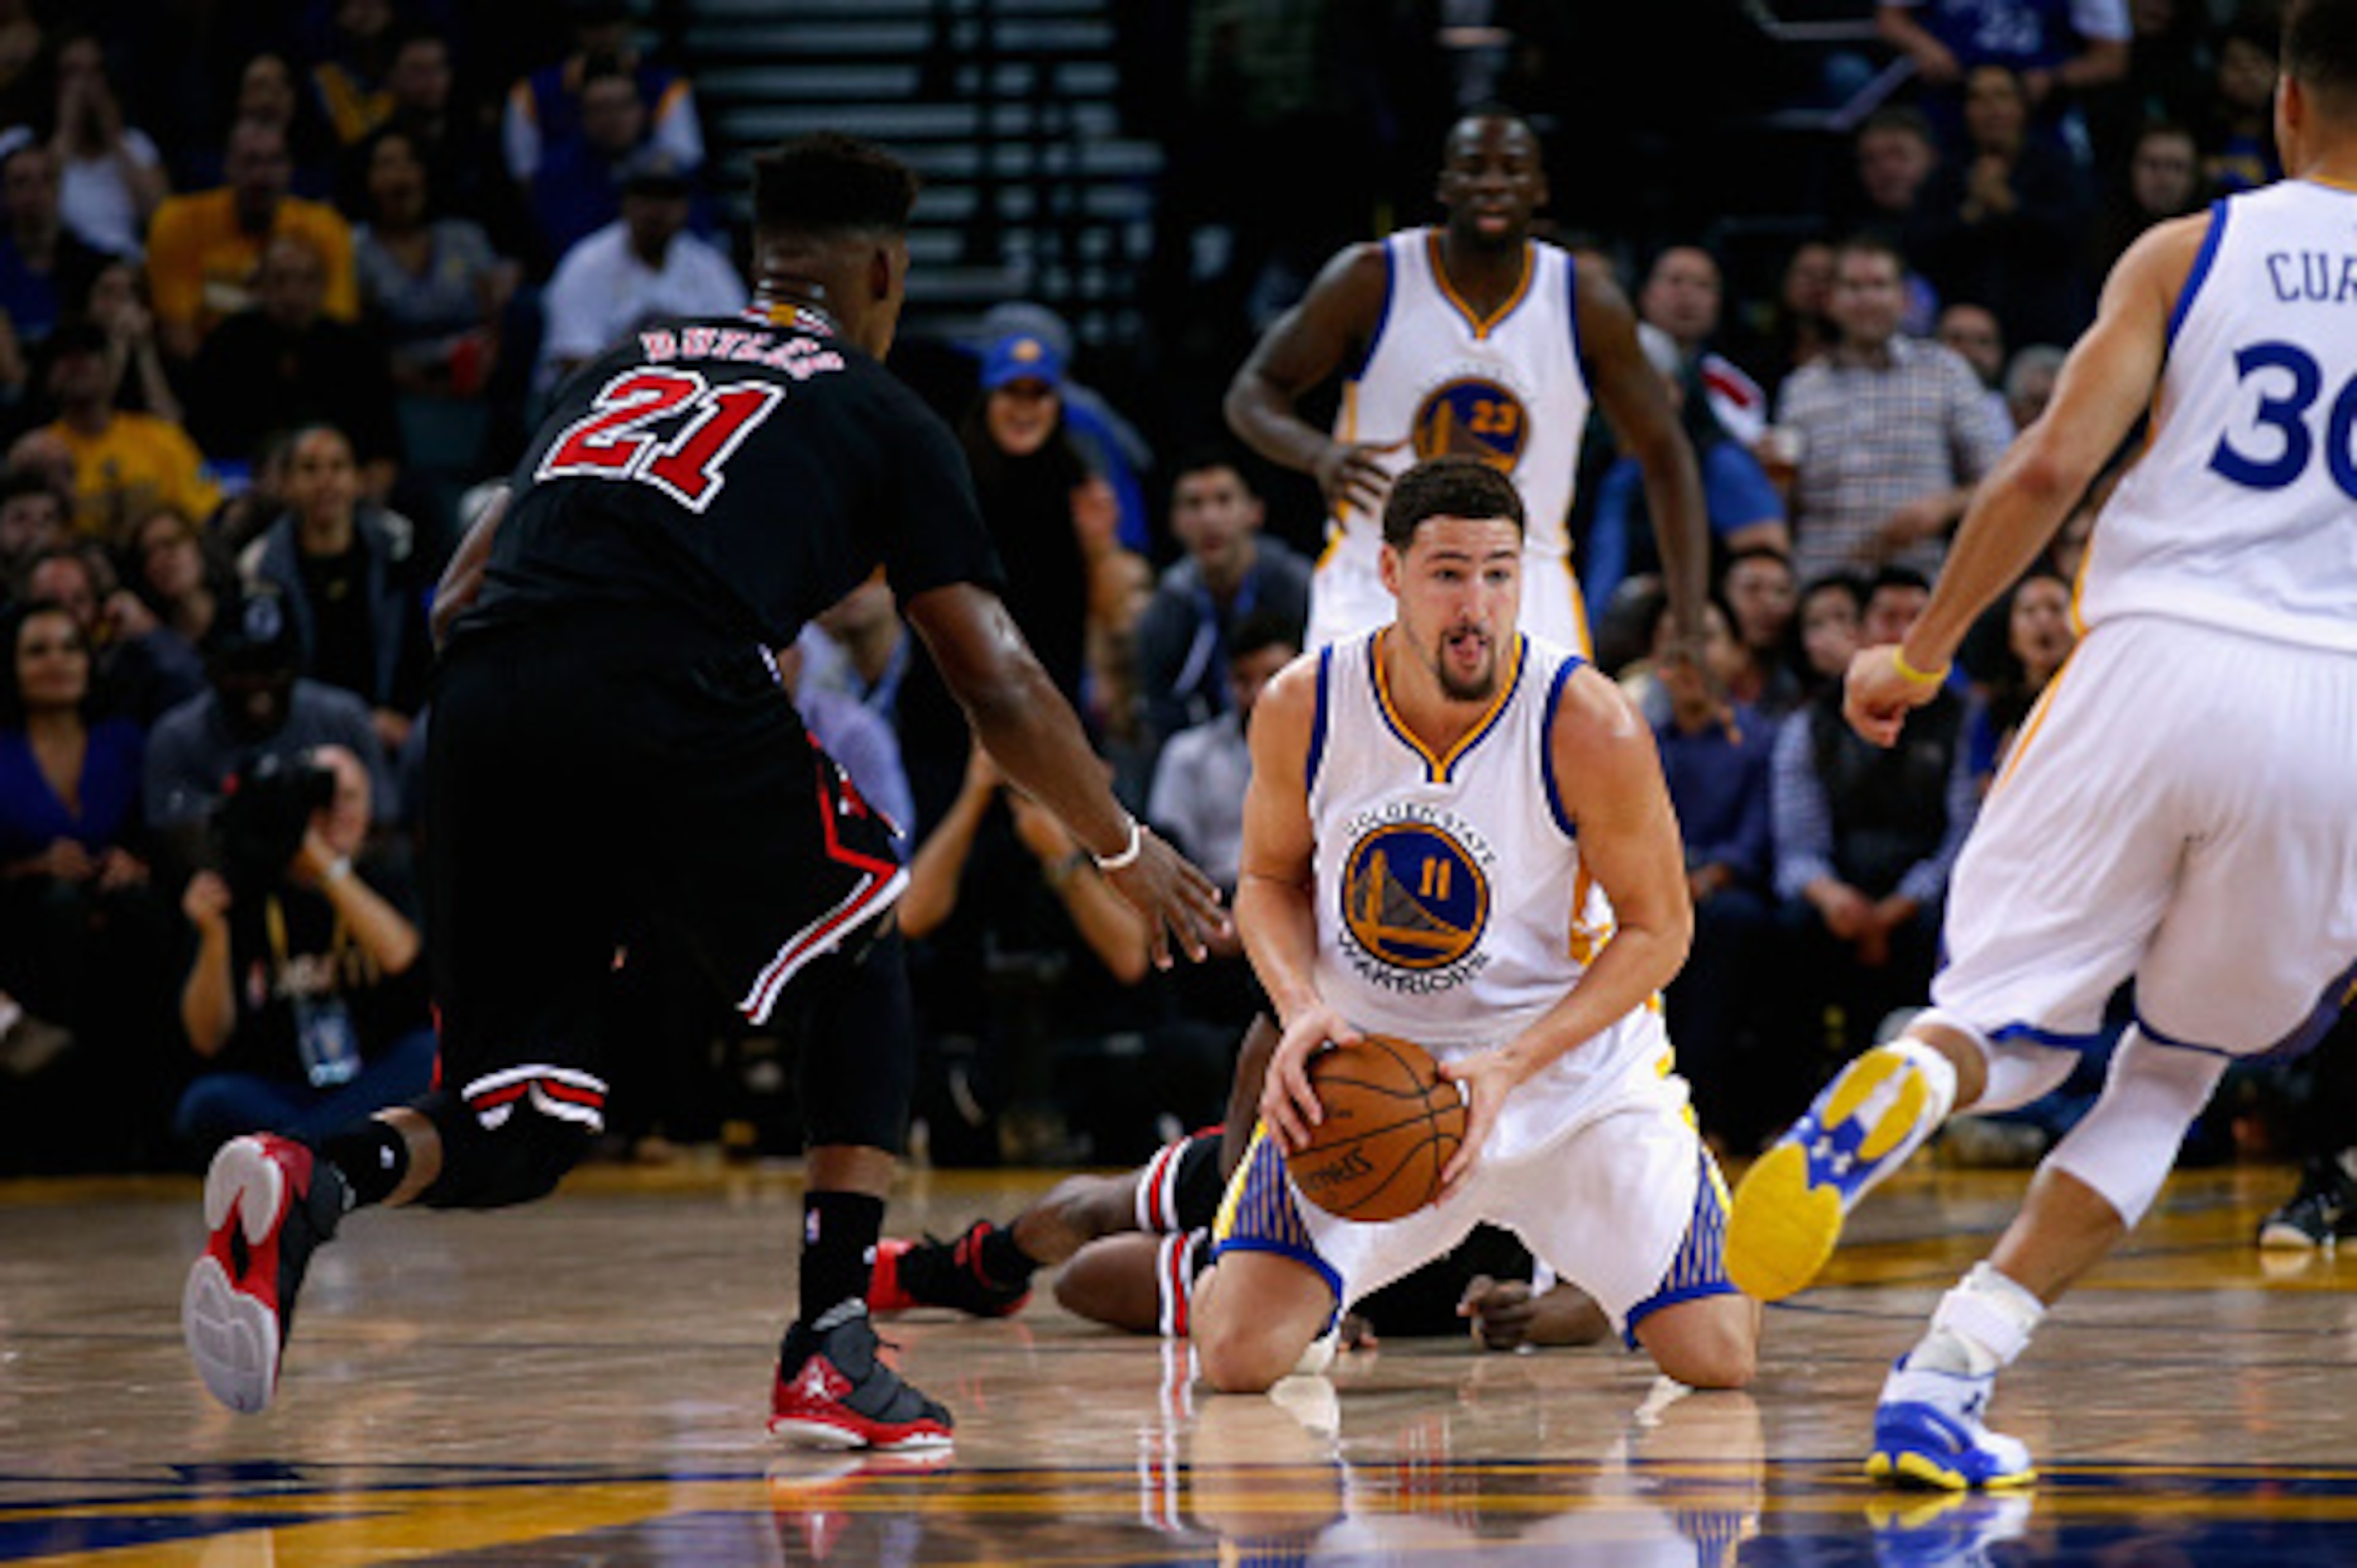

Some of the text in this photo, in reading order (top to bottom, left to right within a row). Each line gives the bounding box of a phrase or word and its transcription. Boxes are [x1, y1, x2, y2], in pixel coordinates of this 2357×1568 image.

[535, 365, 788, 513] 21
[1471, 400, 1517, 436] 23
[1418, 857, 1451, 901] 11
